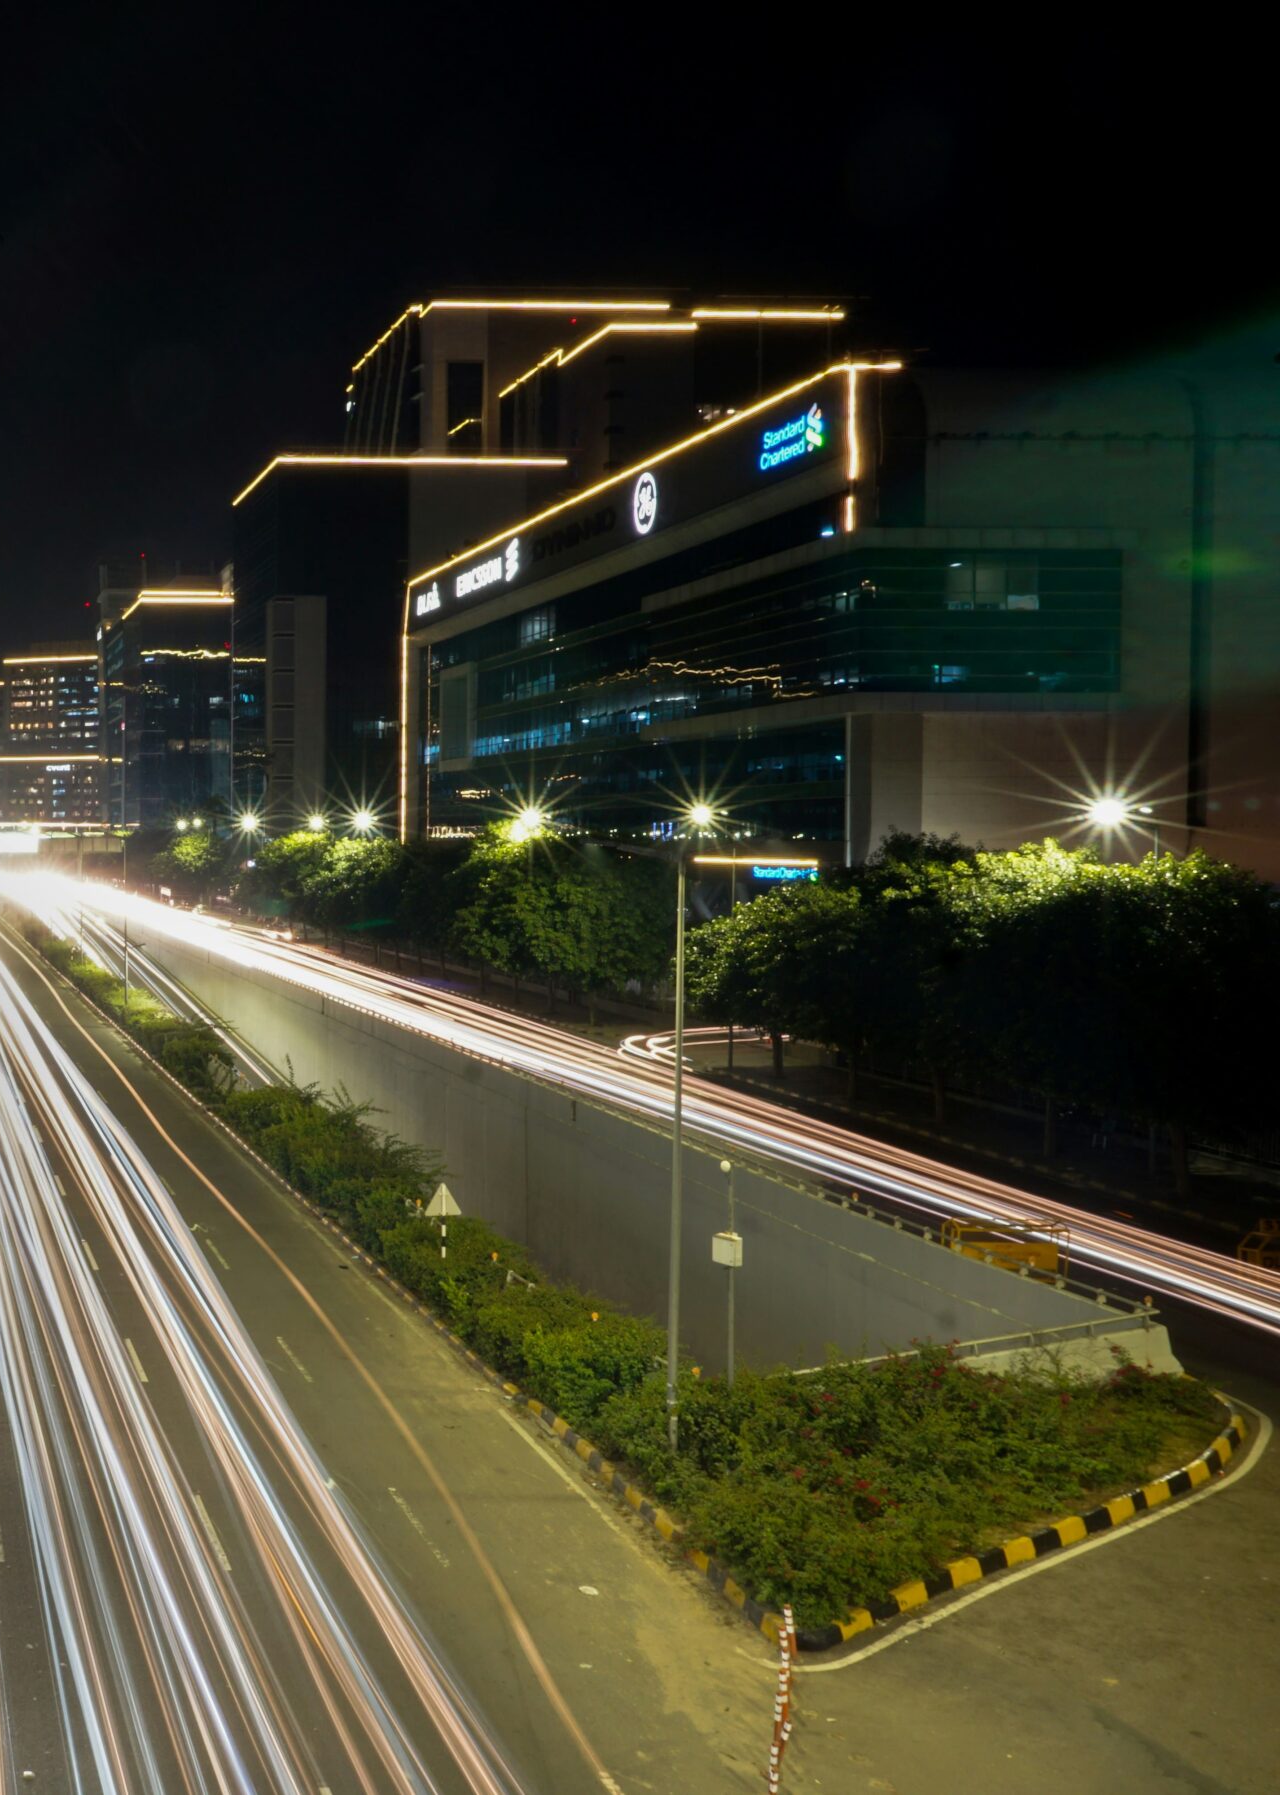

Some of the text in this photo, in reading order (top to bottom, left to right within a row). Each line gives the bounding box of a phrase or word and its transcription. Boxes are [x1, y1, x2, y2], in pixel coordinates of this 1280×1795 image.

[763, 416, 805, 449] Standard
[760, 436, 805, 470] Chartered
[456, 556, 502, 598] ERICSSON
